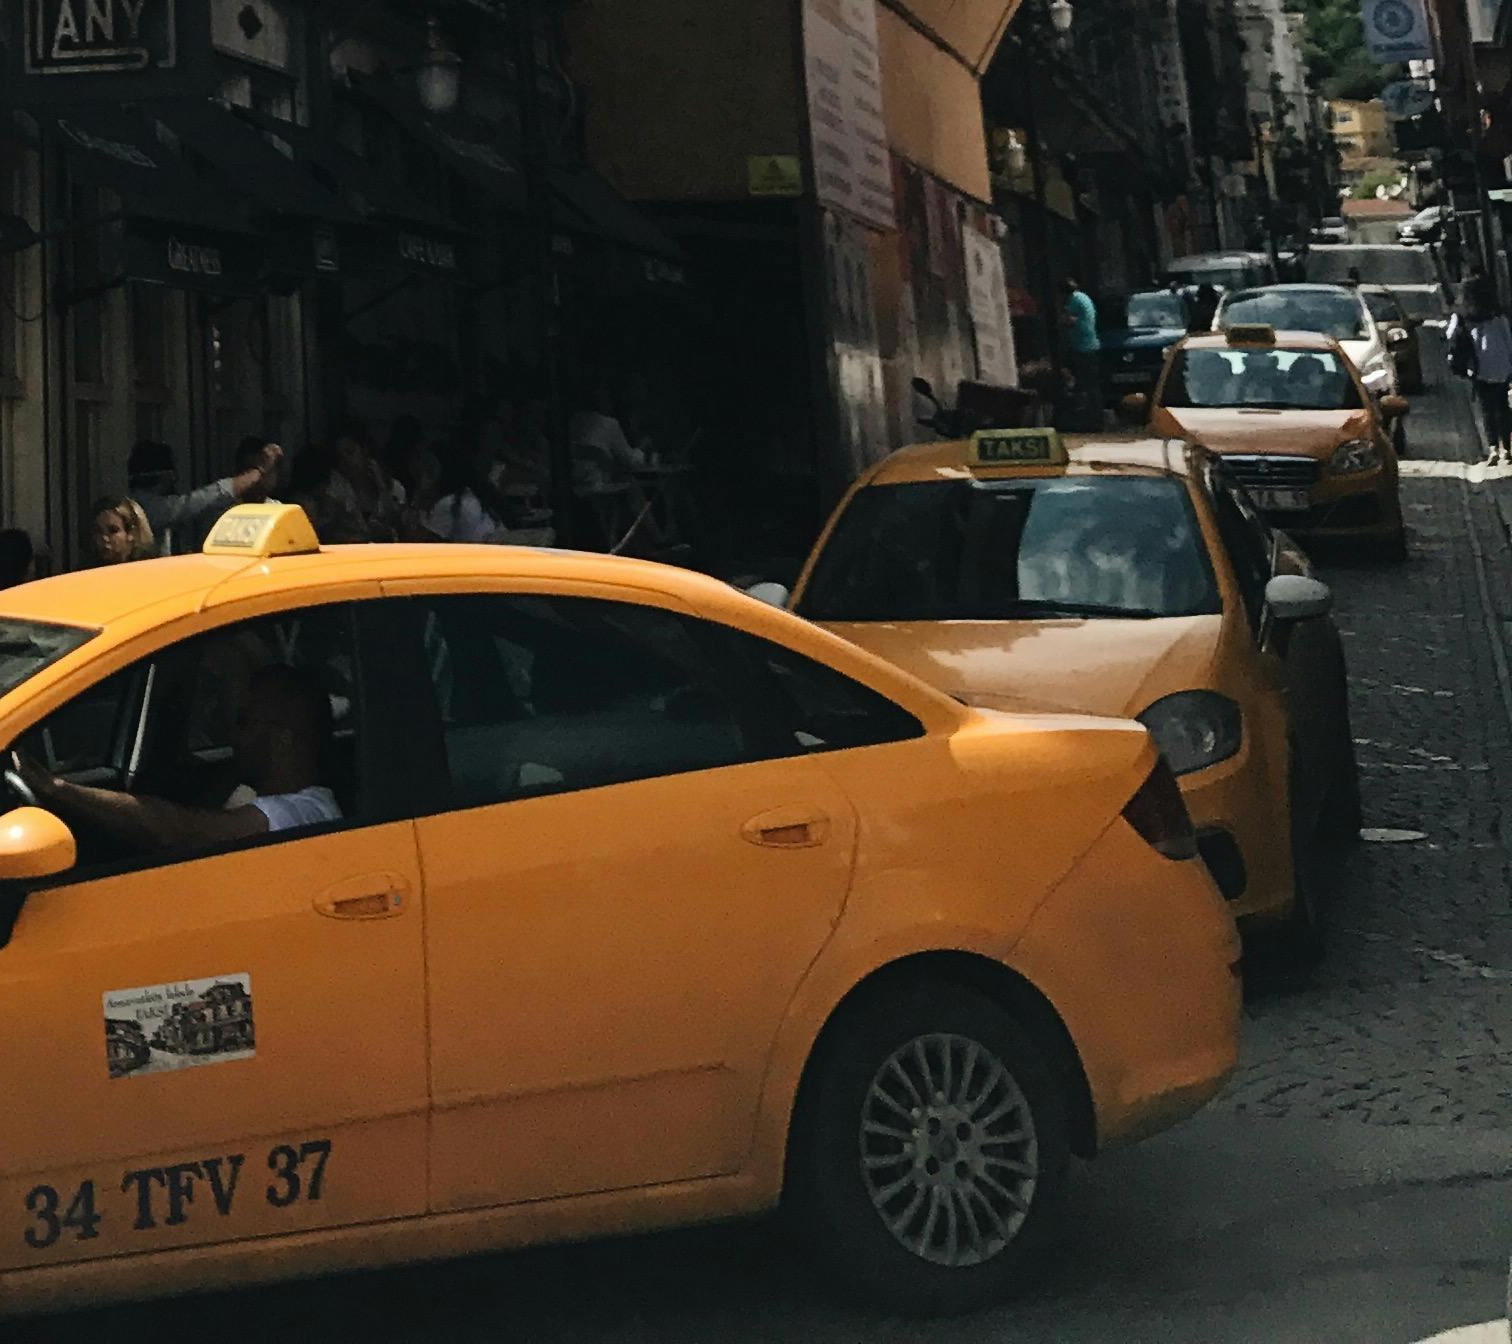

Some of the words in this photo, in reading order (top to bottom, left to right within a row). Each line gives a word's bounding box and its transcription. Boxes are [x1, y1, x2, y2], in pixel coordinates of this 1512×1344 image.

[23, 1178, 102, 1249] 34
[120, 1153, 245, 1231] TFV
[265, 1139, 332, 1208] 37
